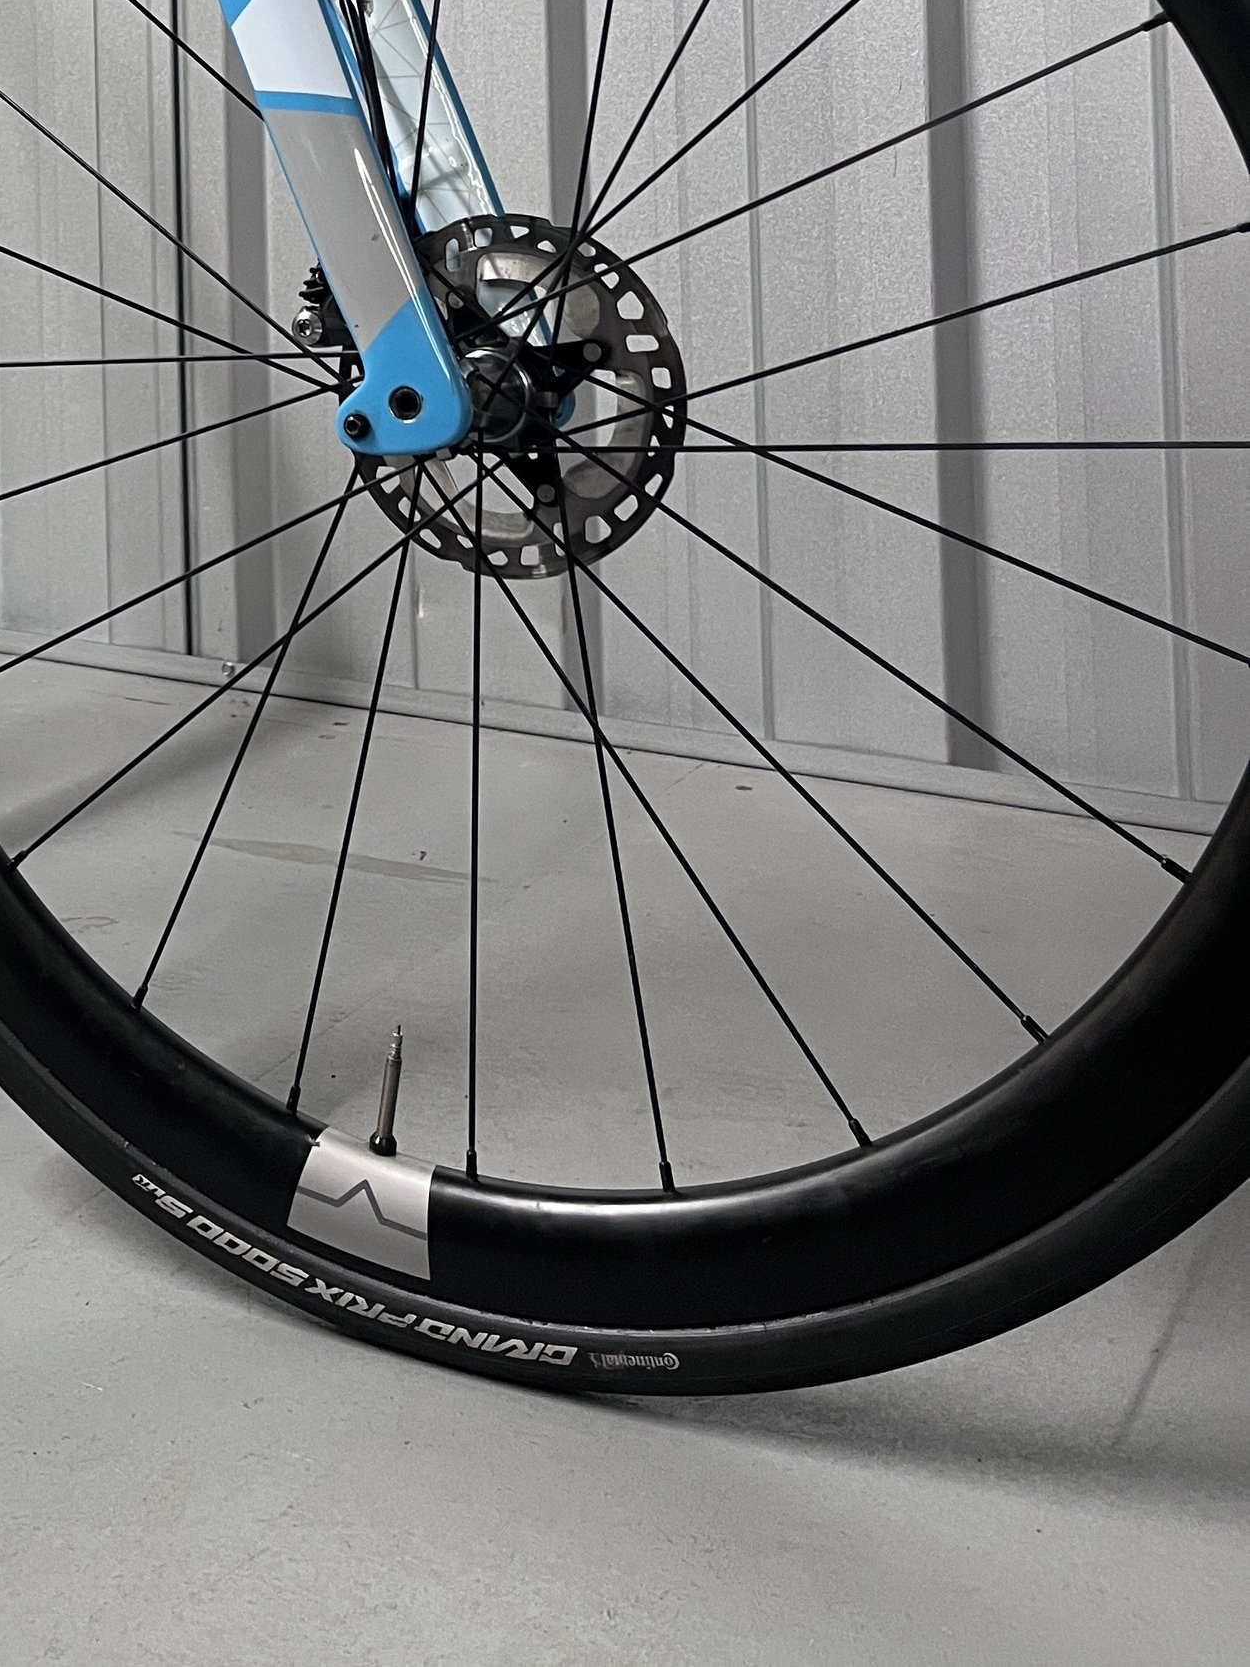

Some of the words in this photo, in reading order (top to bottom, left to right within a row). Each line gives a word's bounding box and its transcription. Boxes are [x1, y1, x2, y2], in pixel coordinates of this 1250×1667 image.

[186, 1215, 310, 1287] 5000
[304, 1277, 417, 1328] PRIX
[415, 1316, 579, 1367] GRAND
